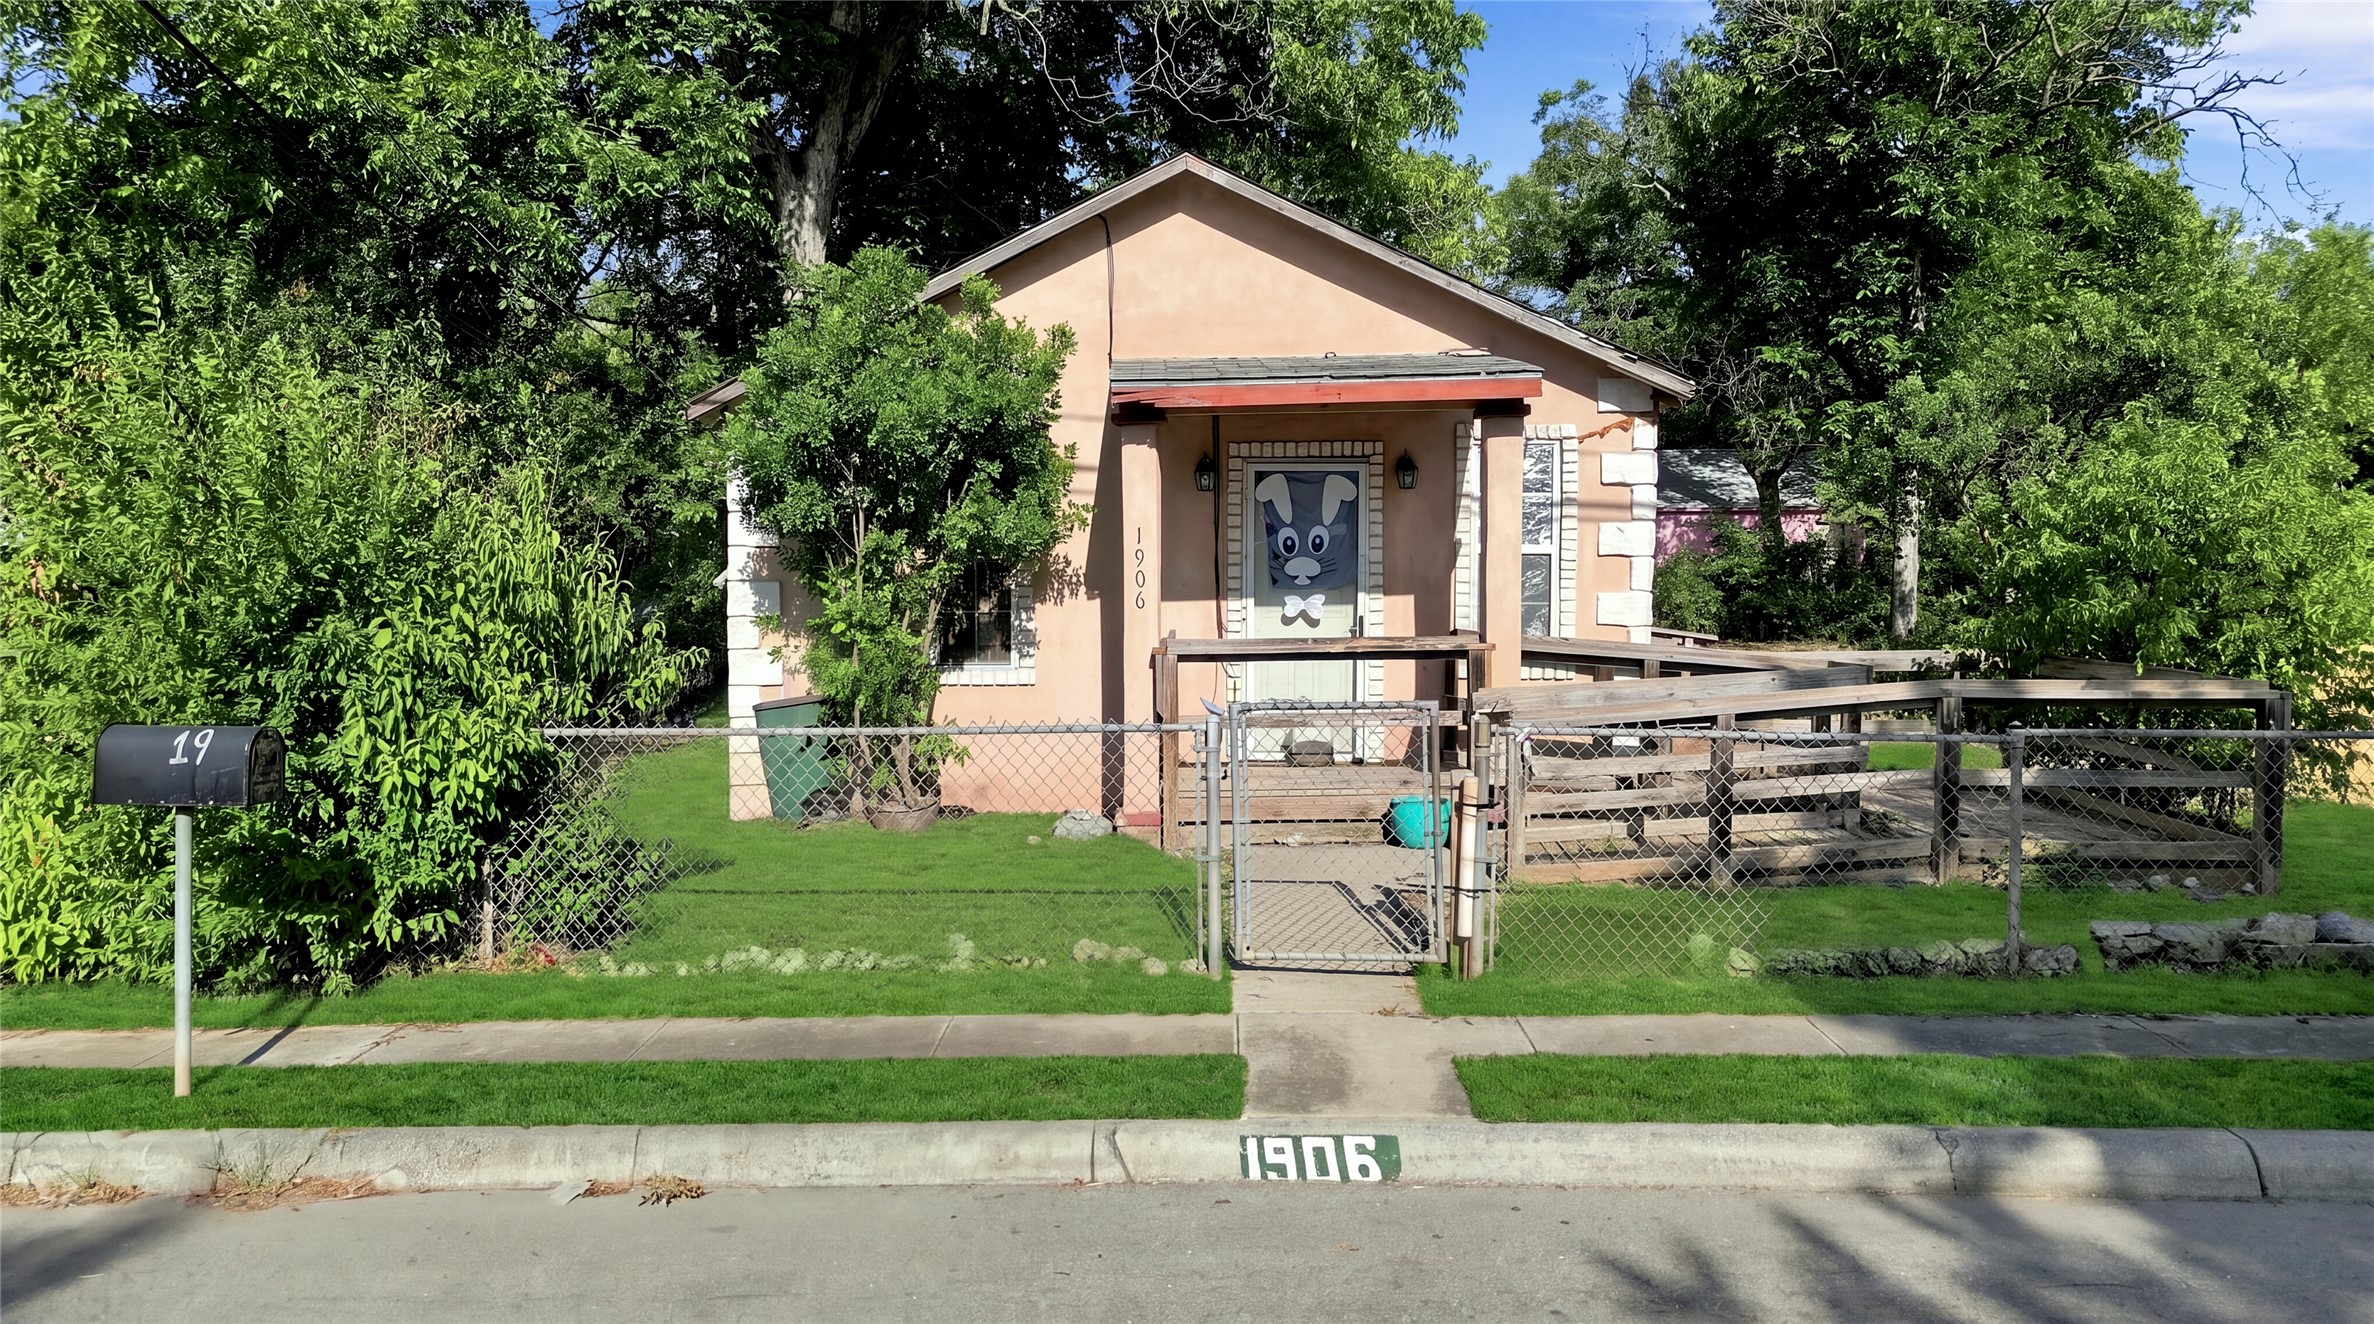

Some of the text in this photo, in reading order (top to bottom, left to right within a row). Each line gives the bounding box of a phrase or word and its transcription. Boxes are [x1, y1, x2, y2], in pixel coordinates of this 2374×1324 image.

[1135, 527, 1145, 609] 1906
[169, 729, 215, 766] 19
[1246, 1136, 1383, 1182] 1906
